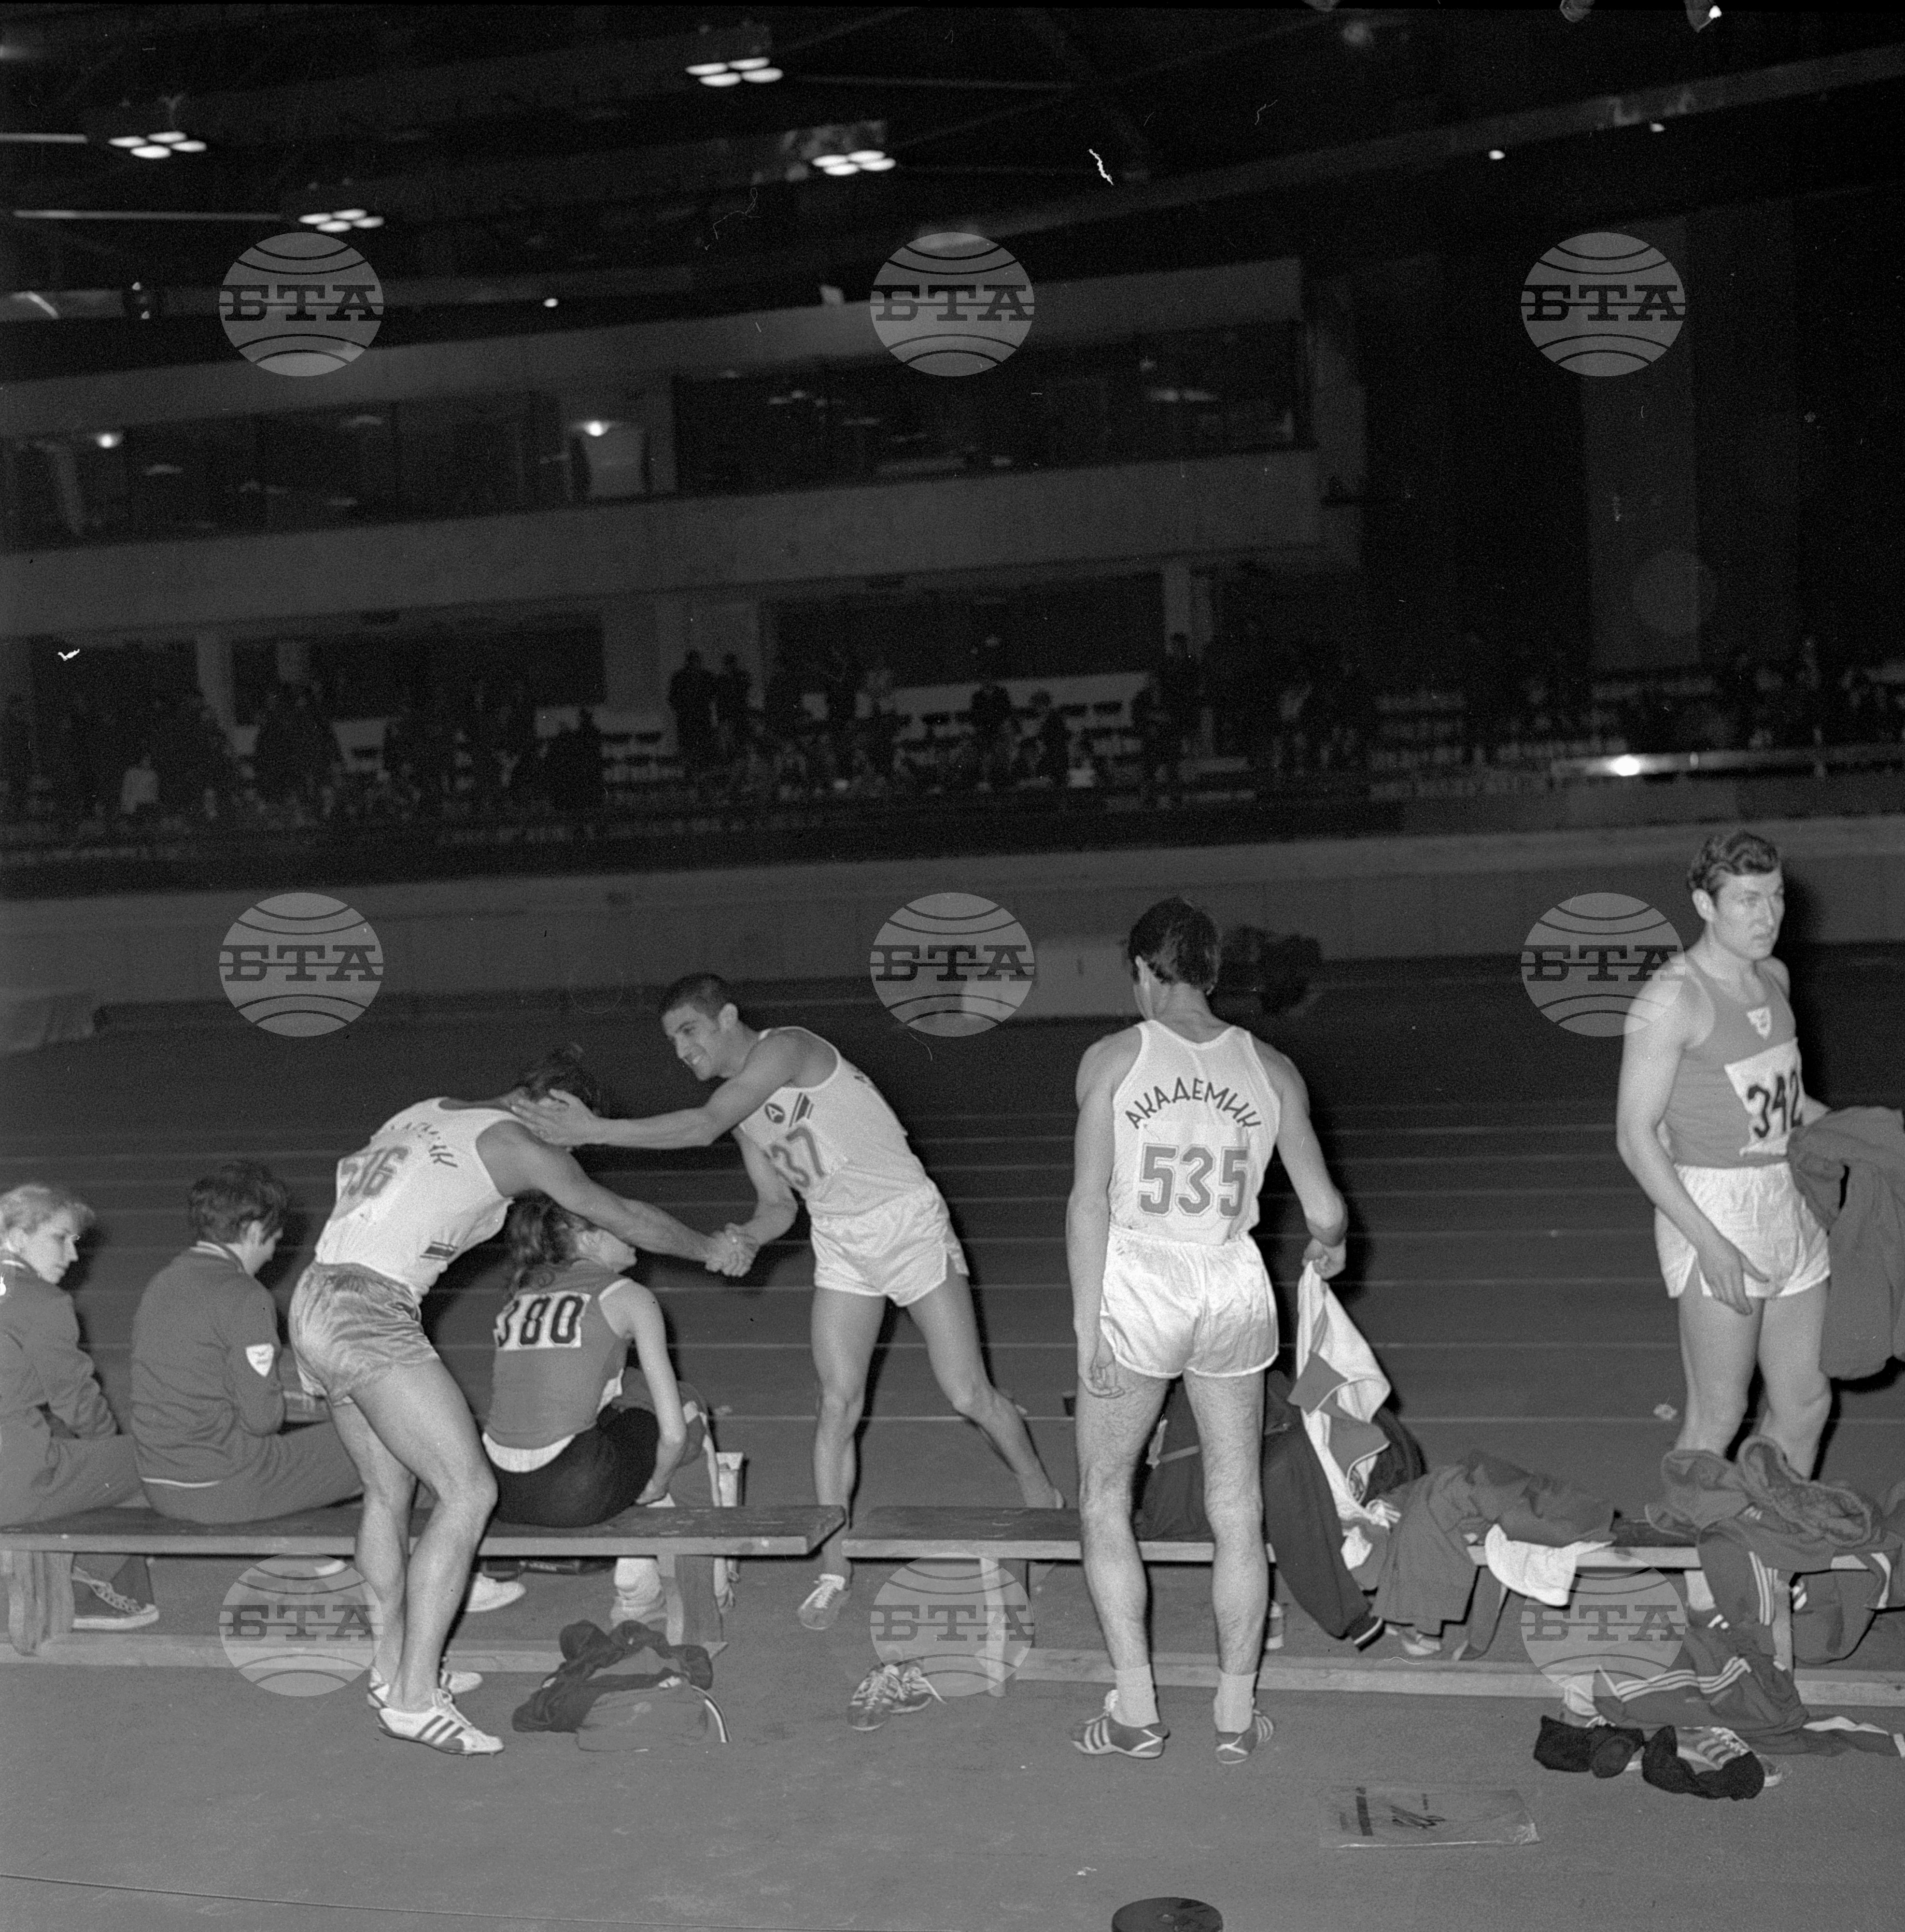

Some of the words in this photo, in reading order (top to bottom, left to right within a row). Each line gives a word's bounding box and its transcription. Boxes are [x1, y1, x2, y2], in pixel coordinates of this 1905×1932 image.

[1125, 1077, 1261, 1130] АКАДЕМИК
[1747, 1068, 1803, 1138] 342
[1138, 1143, 1249, 1219] 535
